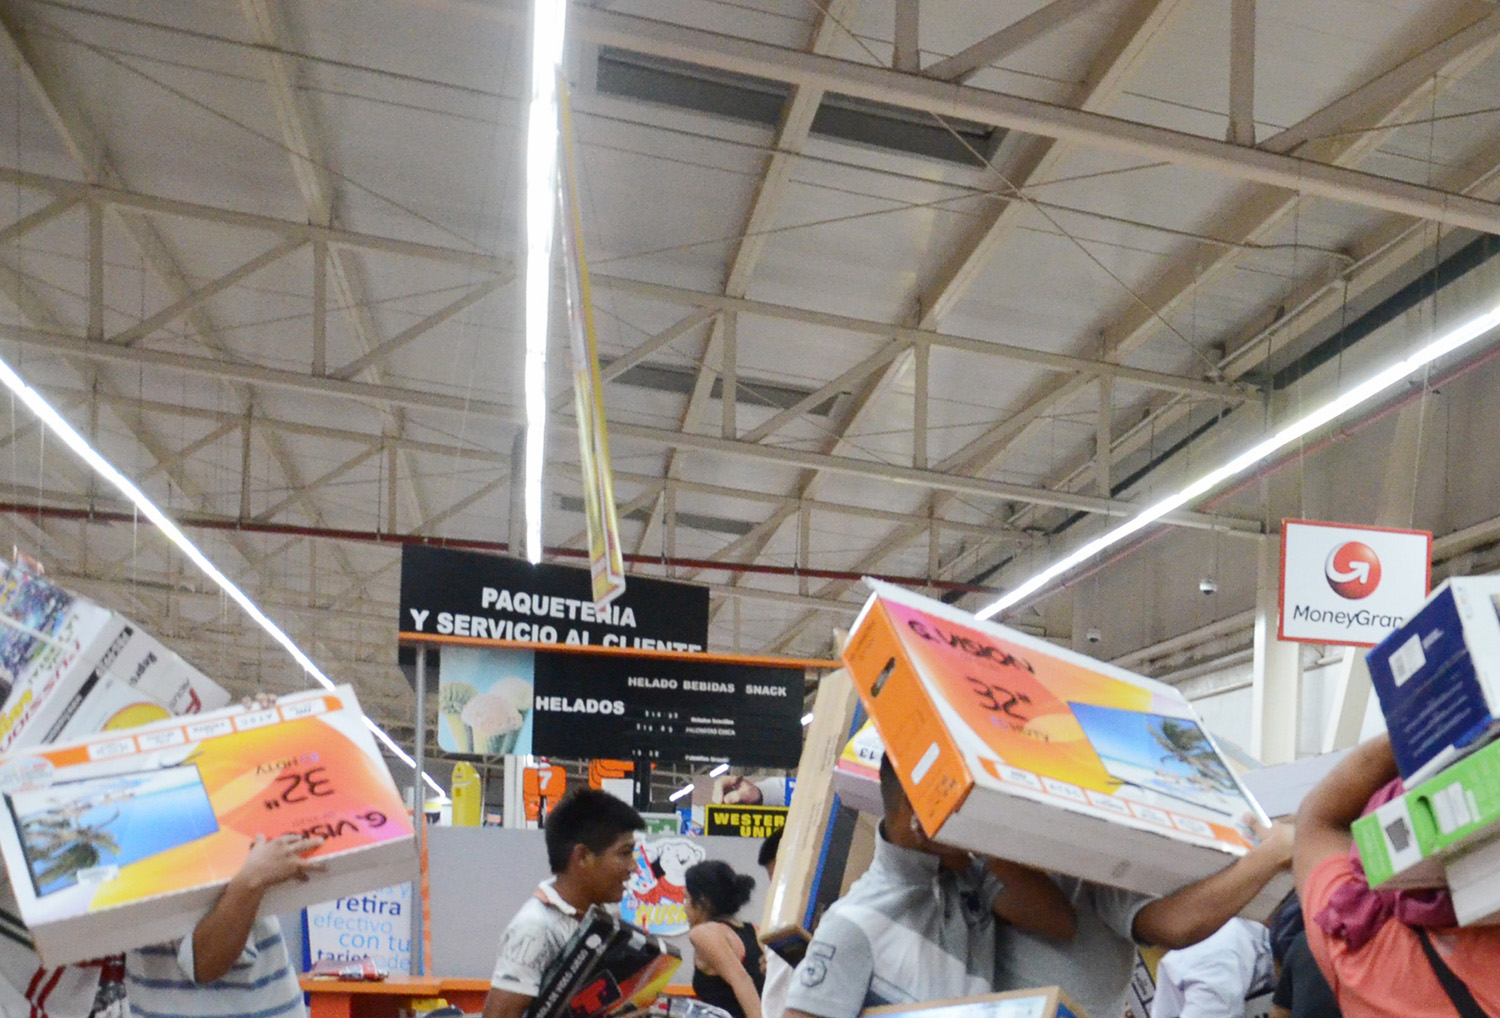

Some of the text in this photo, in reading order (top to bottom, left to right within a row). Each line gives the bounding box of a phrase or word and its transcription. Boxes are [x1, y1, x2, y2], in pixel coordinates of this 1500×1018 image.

[481, 586, 638, 629] PAQUETERIA
[409, 607, 430, 632] Y
[436, 611, 558, 644] SERVICIO
[628, 676, 787, 697] HELADO BEBIDAS SNACK
[535, 696, 625, 715] HELADOS
[265, 766, 334, 811] 32"
[538, 771, 552, 790] 7
[713, 811, 787, 828] WESTER
[739, 825, 771, 839] UNI
[336, 895, 401, 916] retira
[635, 903, 688, 926] SLUSH
[313, 911, 393, 934] efectivo
[339, 932, 411, 952] con tu
